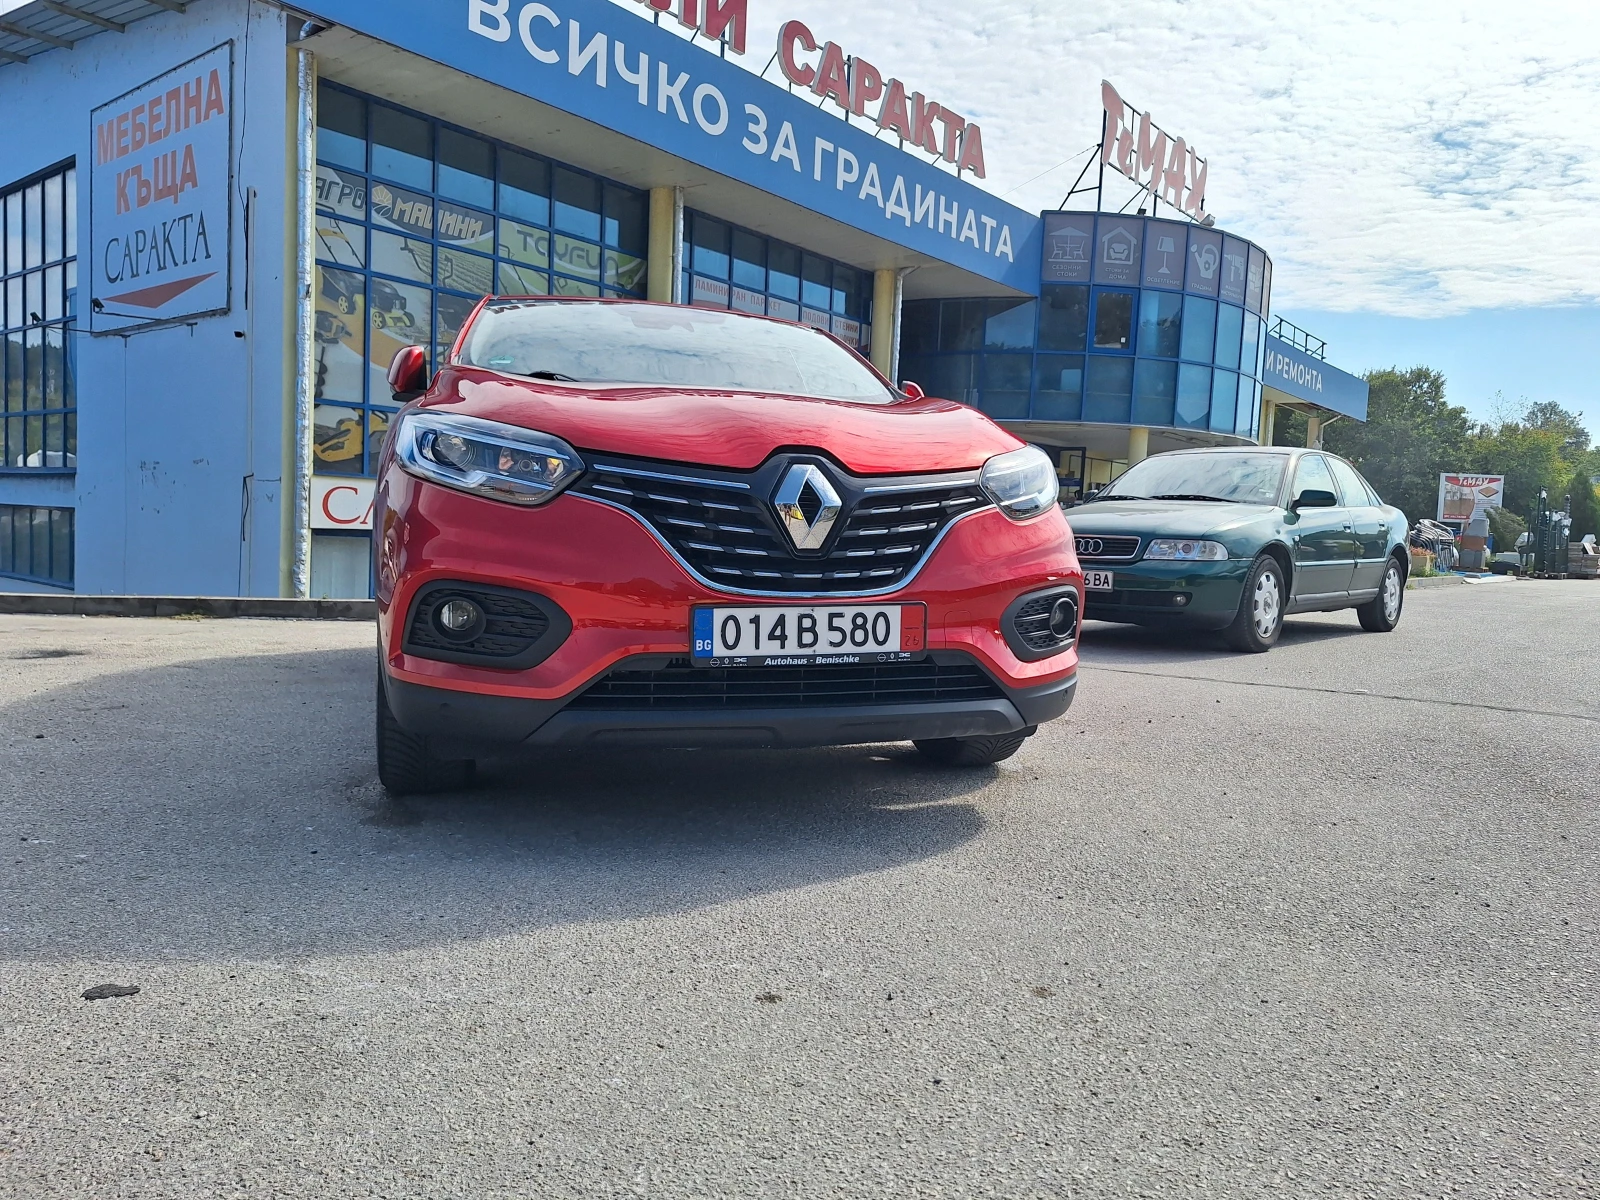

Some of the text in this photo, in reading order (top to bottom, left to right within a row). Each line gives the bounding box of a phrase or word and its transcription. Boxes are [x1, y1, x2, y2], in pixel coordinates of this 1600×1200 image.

[97, 67, 225, 167] МЕБЕЛНА
[468, 0, 1014, 263] ВСИЧКО ЗА ГРАДИНАТА
[777, 19, 986, 179] САРАКТА
[116, 143, 199, 215] КЪЩА
[316, 176, 483, 241] АГРО МАШИНИ
[104, 209, 212, 285] САРАКТА
[695, 279, 782, 311] ЛАМИНИРАН ПАРКЕТ
[1191, 282, 1213, 292] ГРАДИНА
[1266, 348, 1322, 393] И РЕМОНТА
[695, 640, 712, 651] BG
[764, 656, 808, 666] Autohaus
[815, 655, 860, 665] Benischke
